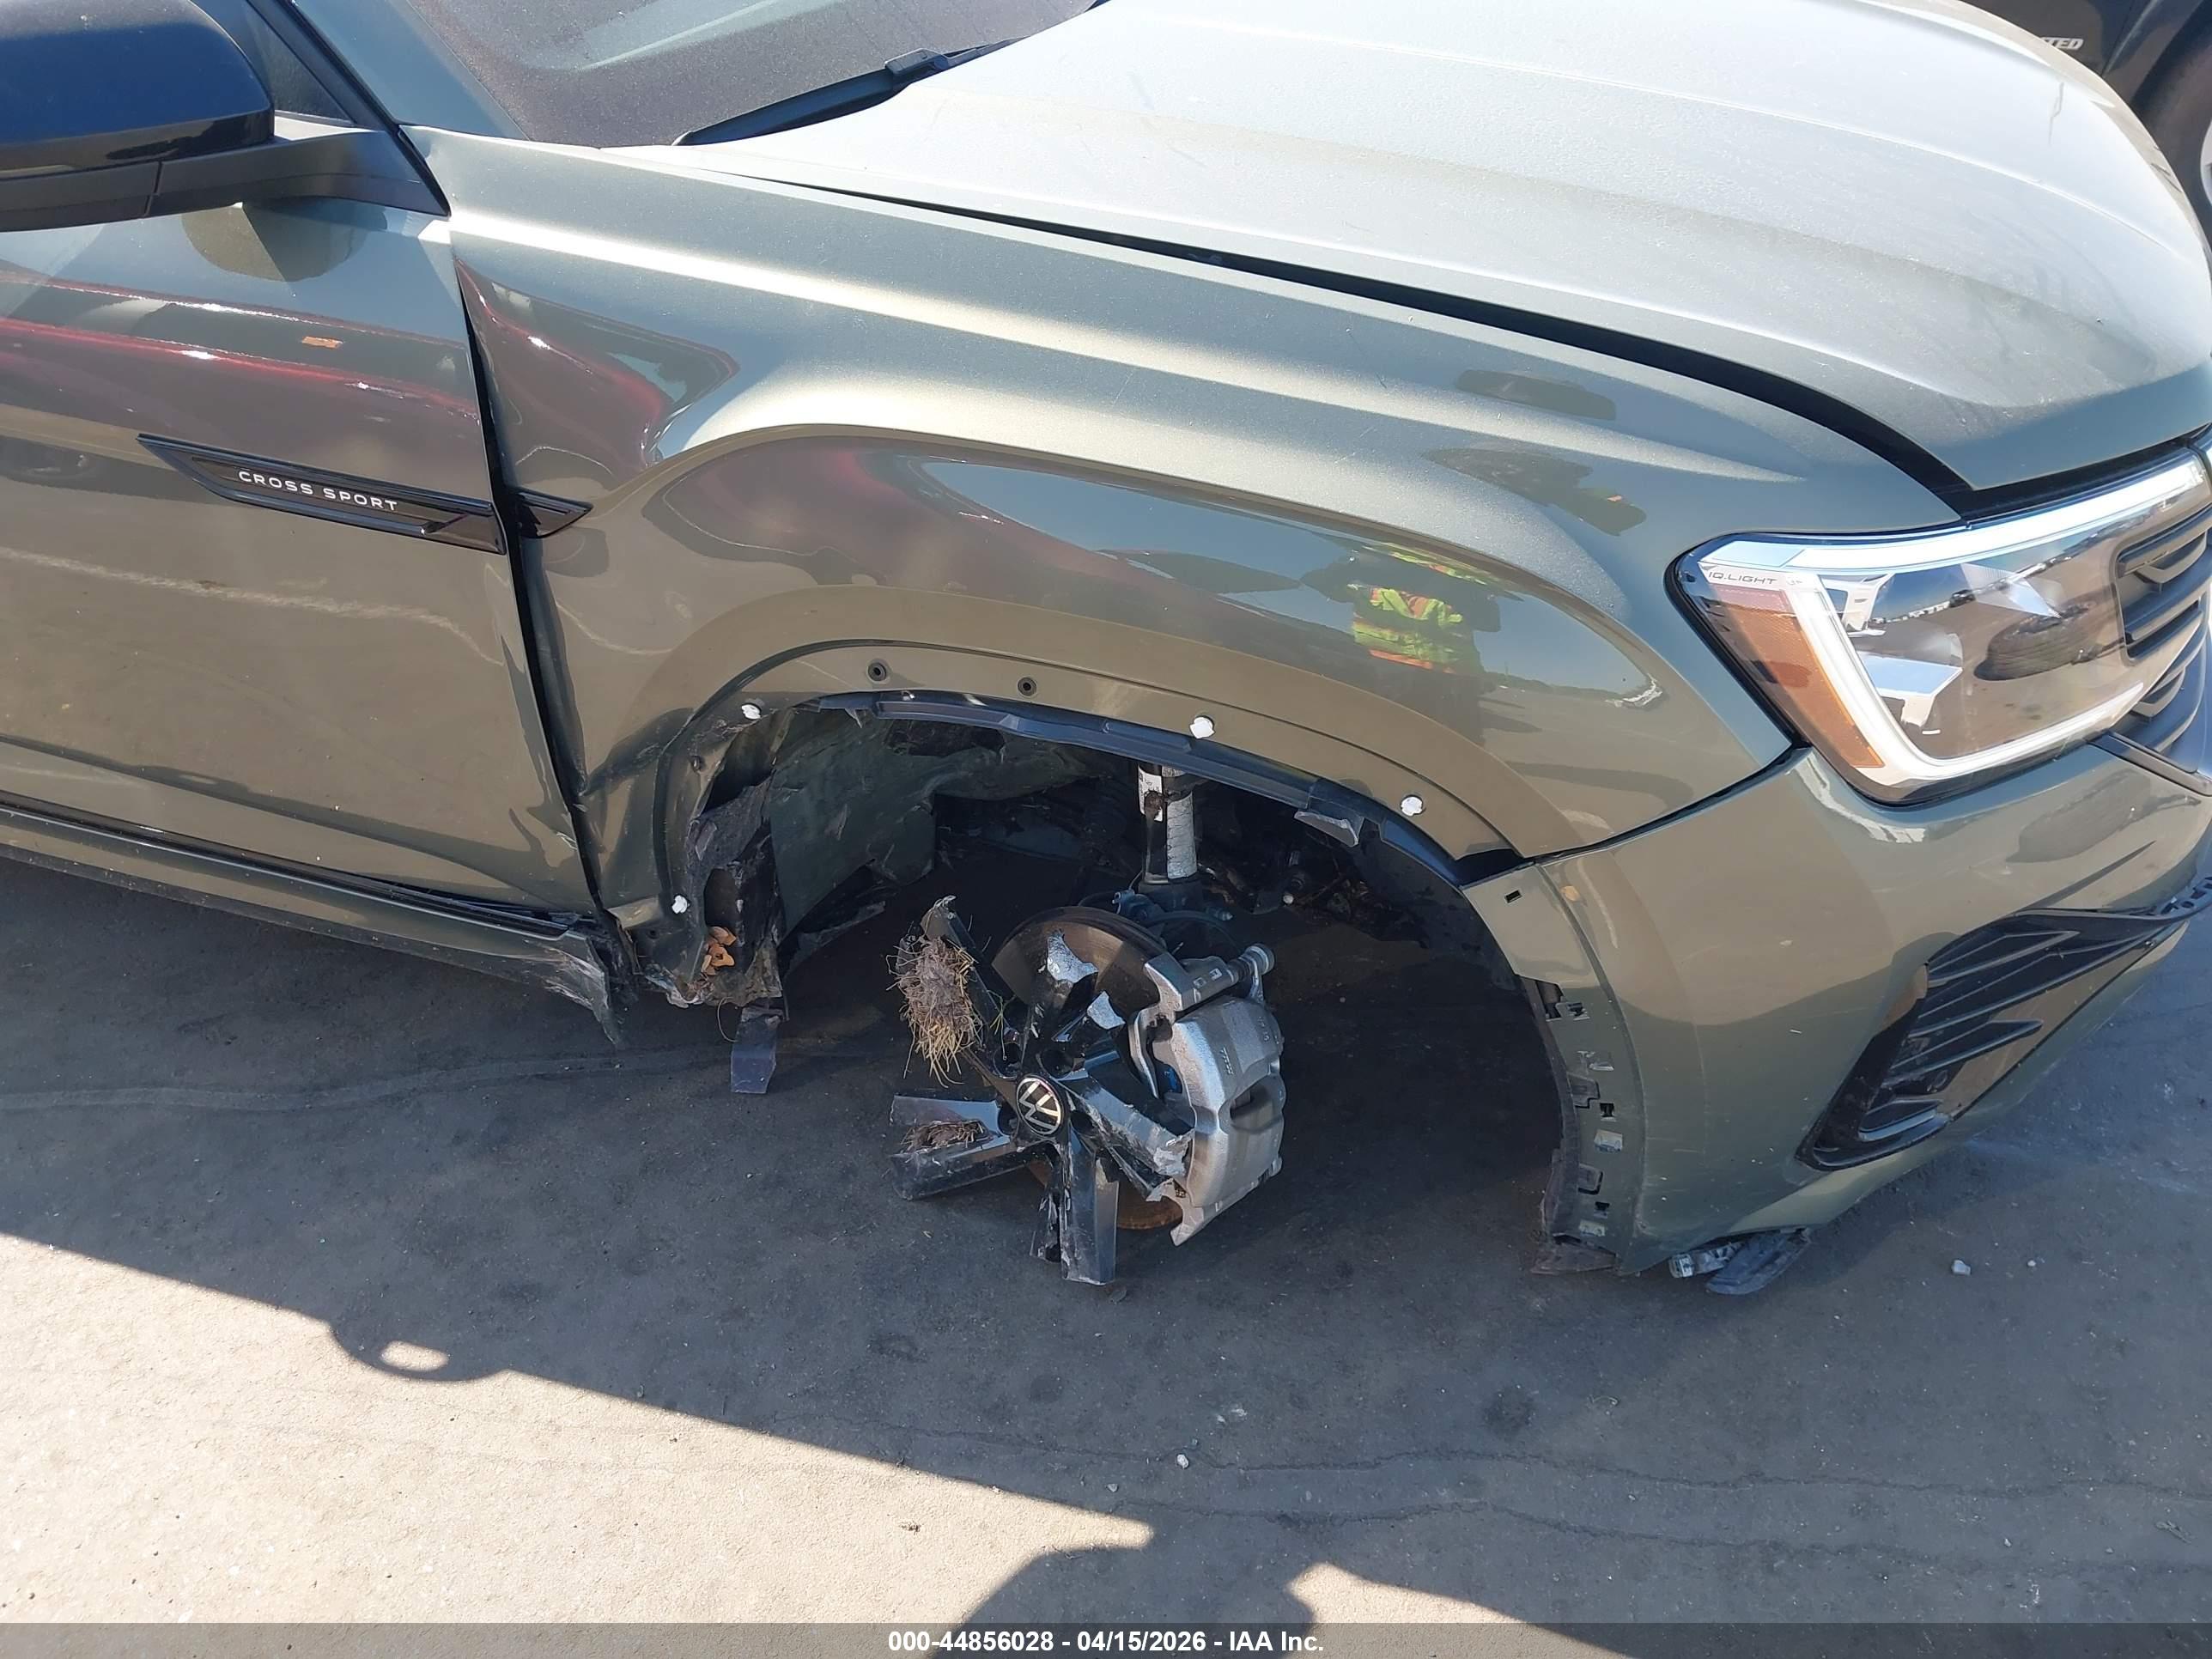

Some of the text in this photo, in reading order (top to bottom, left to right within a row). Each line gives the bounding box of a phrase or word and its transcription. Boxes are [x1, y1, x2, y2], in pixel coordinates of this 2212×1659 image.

[239, 471, 397, 511] CROSS SPORT
[1709, 571, 1778, 585] IQ.LIGHT
